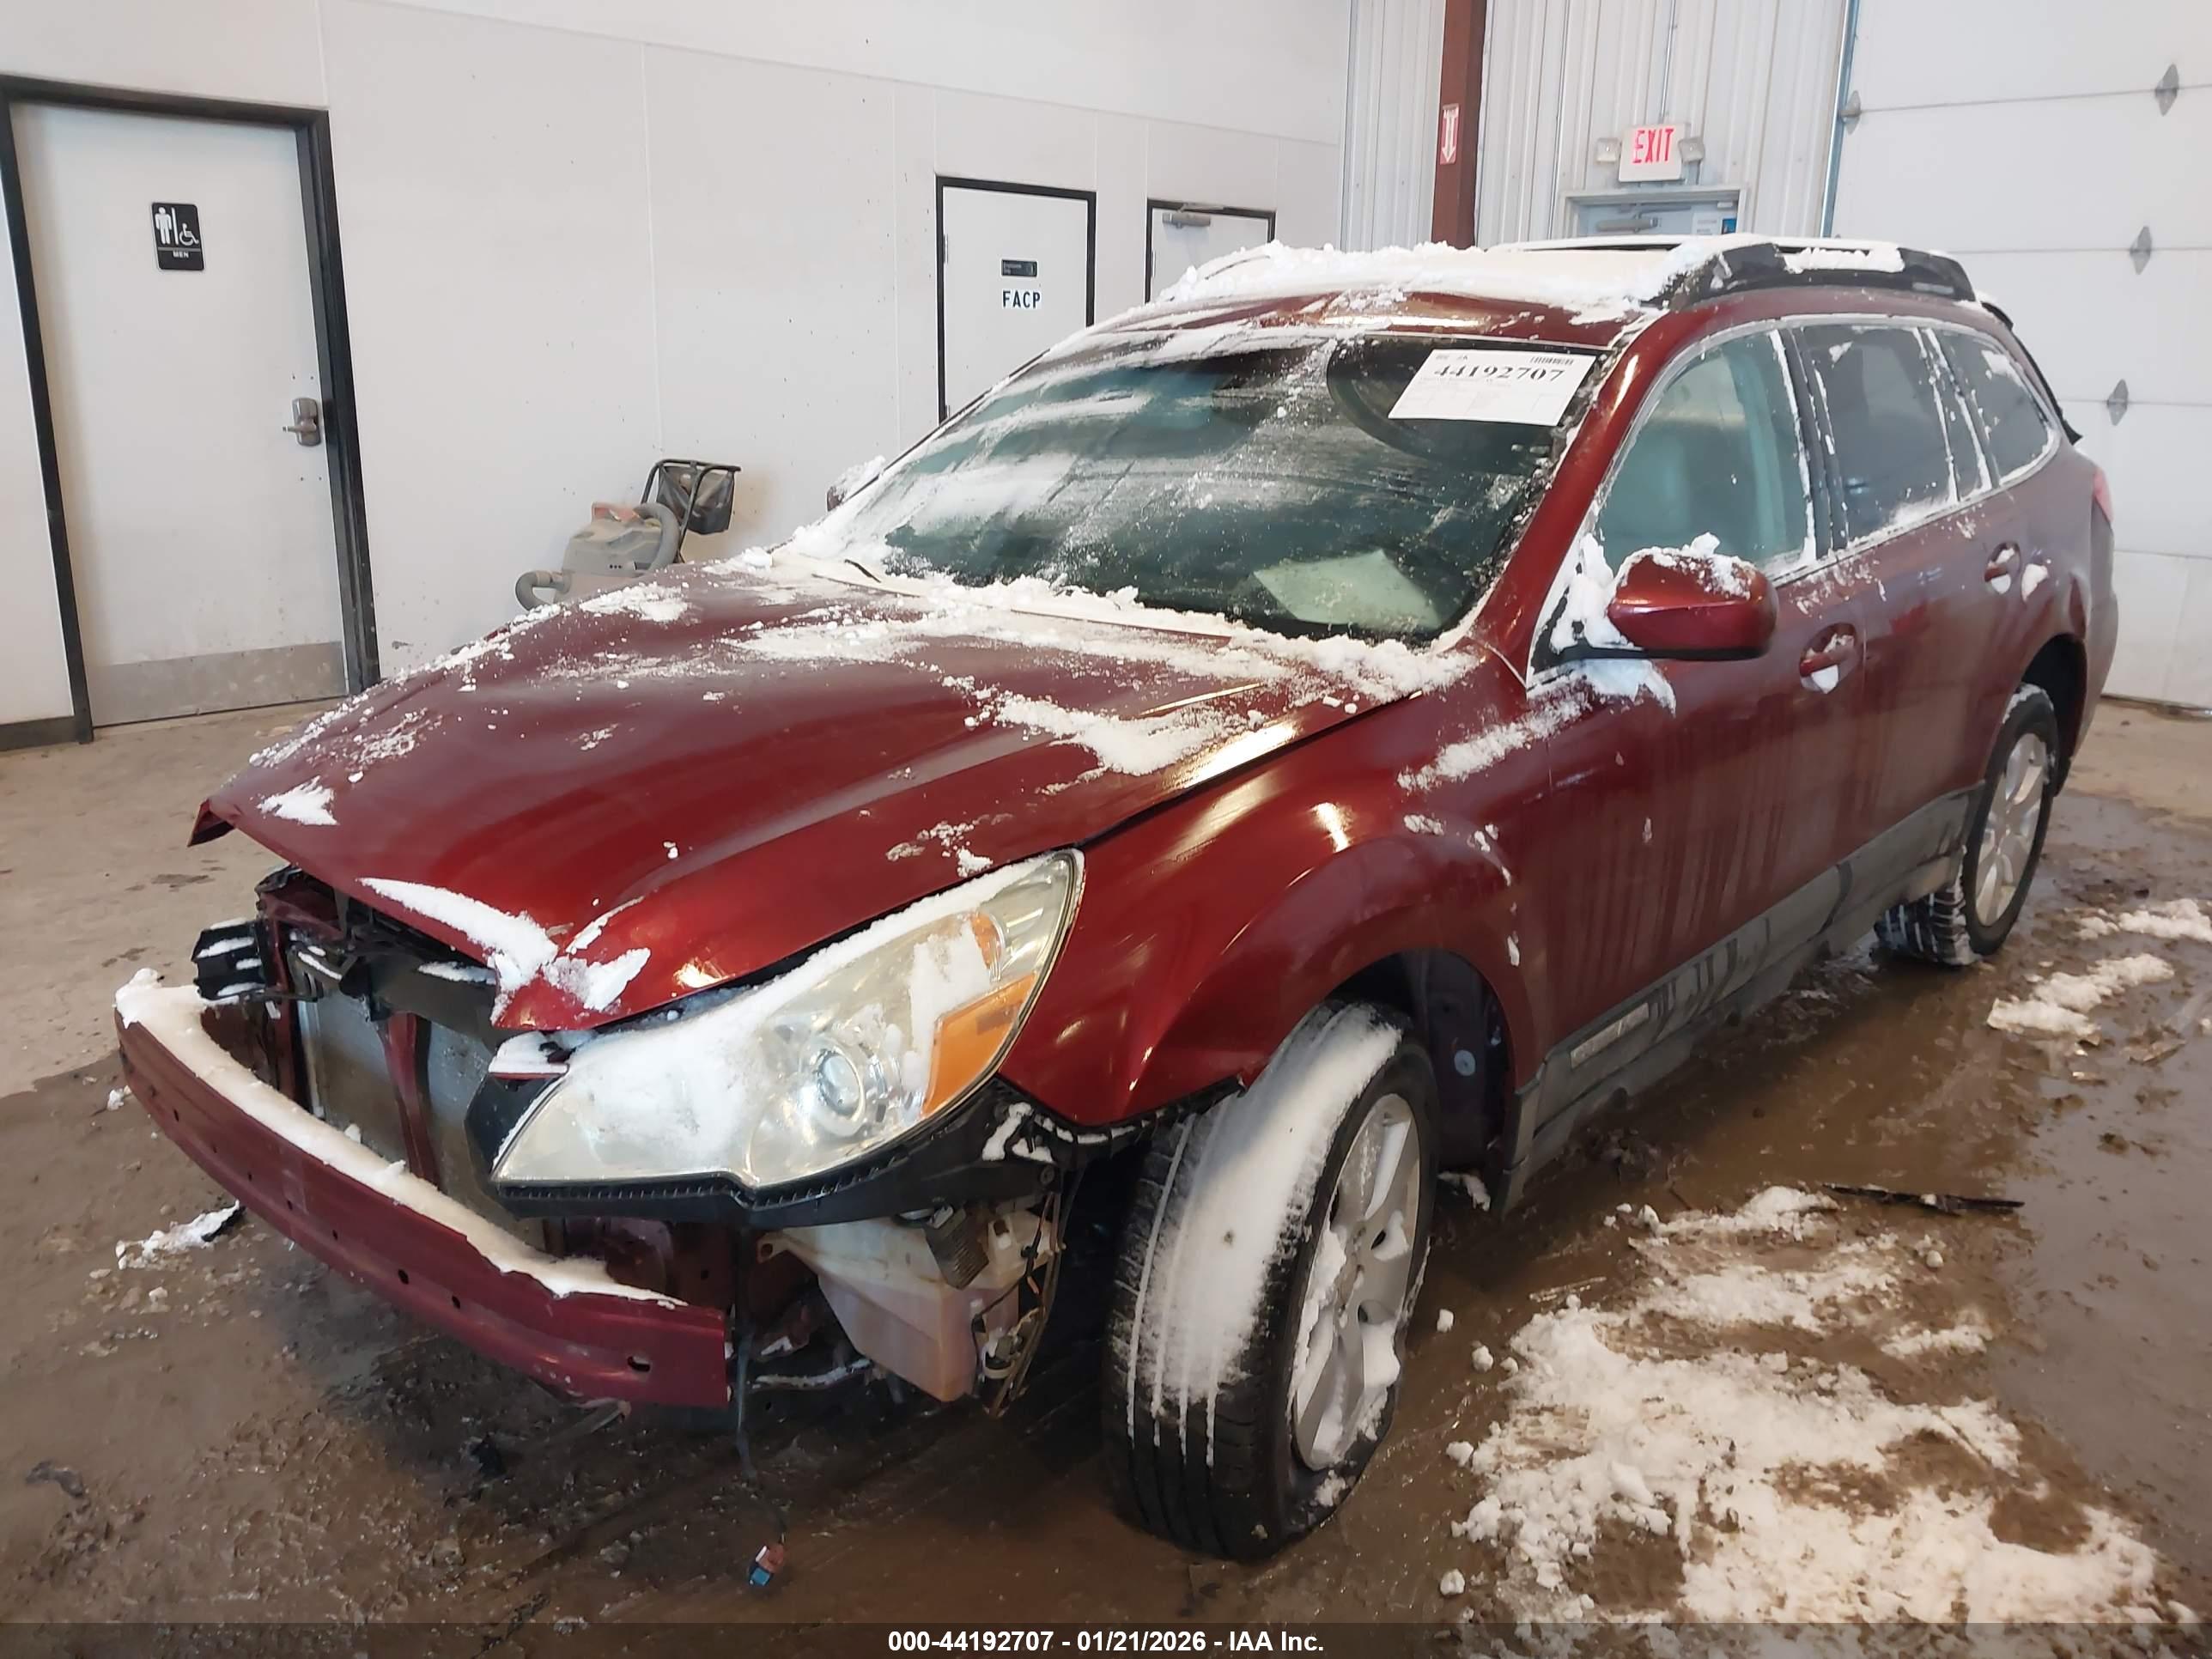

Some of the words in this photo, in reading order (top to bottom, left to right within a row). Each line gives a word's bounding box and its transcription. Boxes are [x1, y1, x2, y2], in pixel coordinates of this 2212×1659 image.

[1632, 128, 1674, 163] EXIT
[173, 250, 189, 258] MEN
[1002, 289, 1041, 309] FACP
[1433, 363, 1565, 382] 44192707
